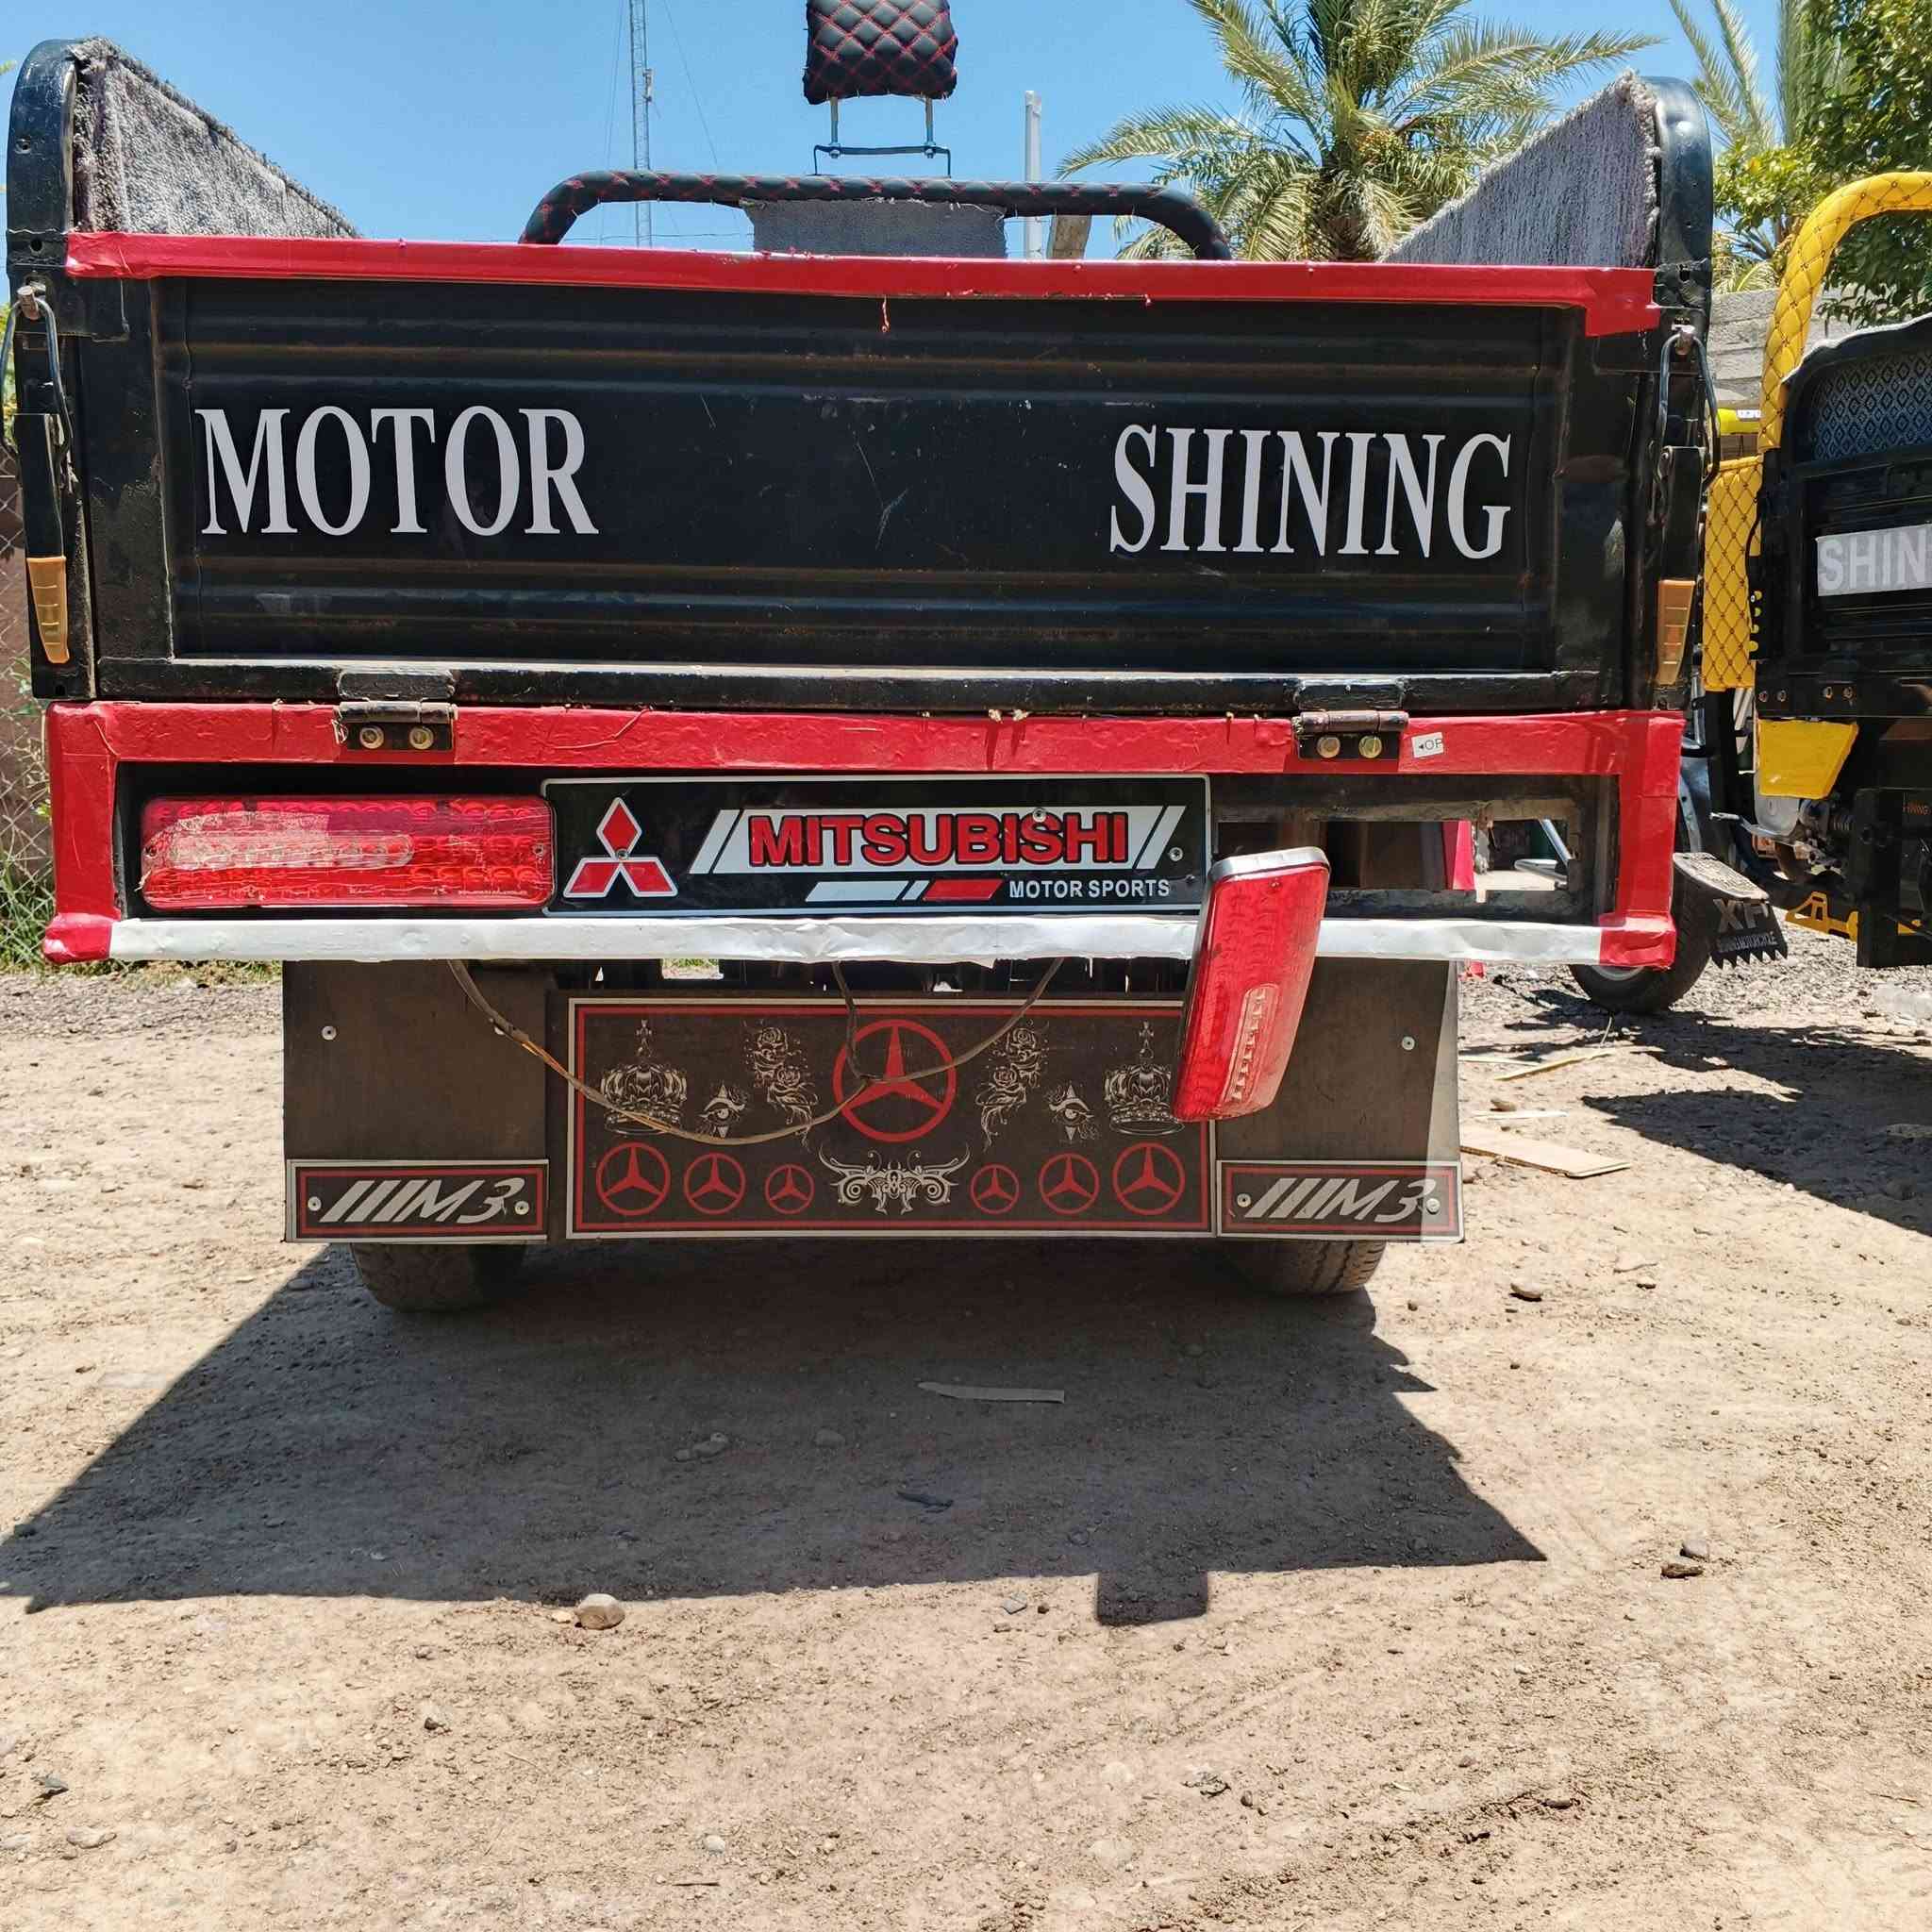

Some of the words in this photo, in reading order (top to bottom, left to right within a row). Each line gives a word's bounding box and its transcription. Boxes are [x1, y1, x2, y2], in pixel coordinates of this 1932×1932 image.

[194, 405, 600, 537] MOTOR
[1109, 424, 1512, 559] SHINING
[1819, 529, 1927, 591] SHIN
[748, 811, 1129, 867] MITSUBISHI
[1008, 880, 1084, 898] MOTOR
[1088, 879, 1171, 898] SPORTS
